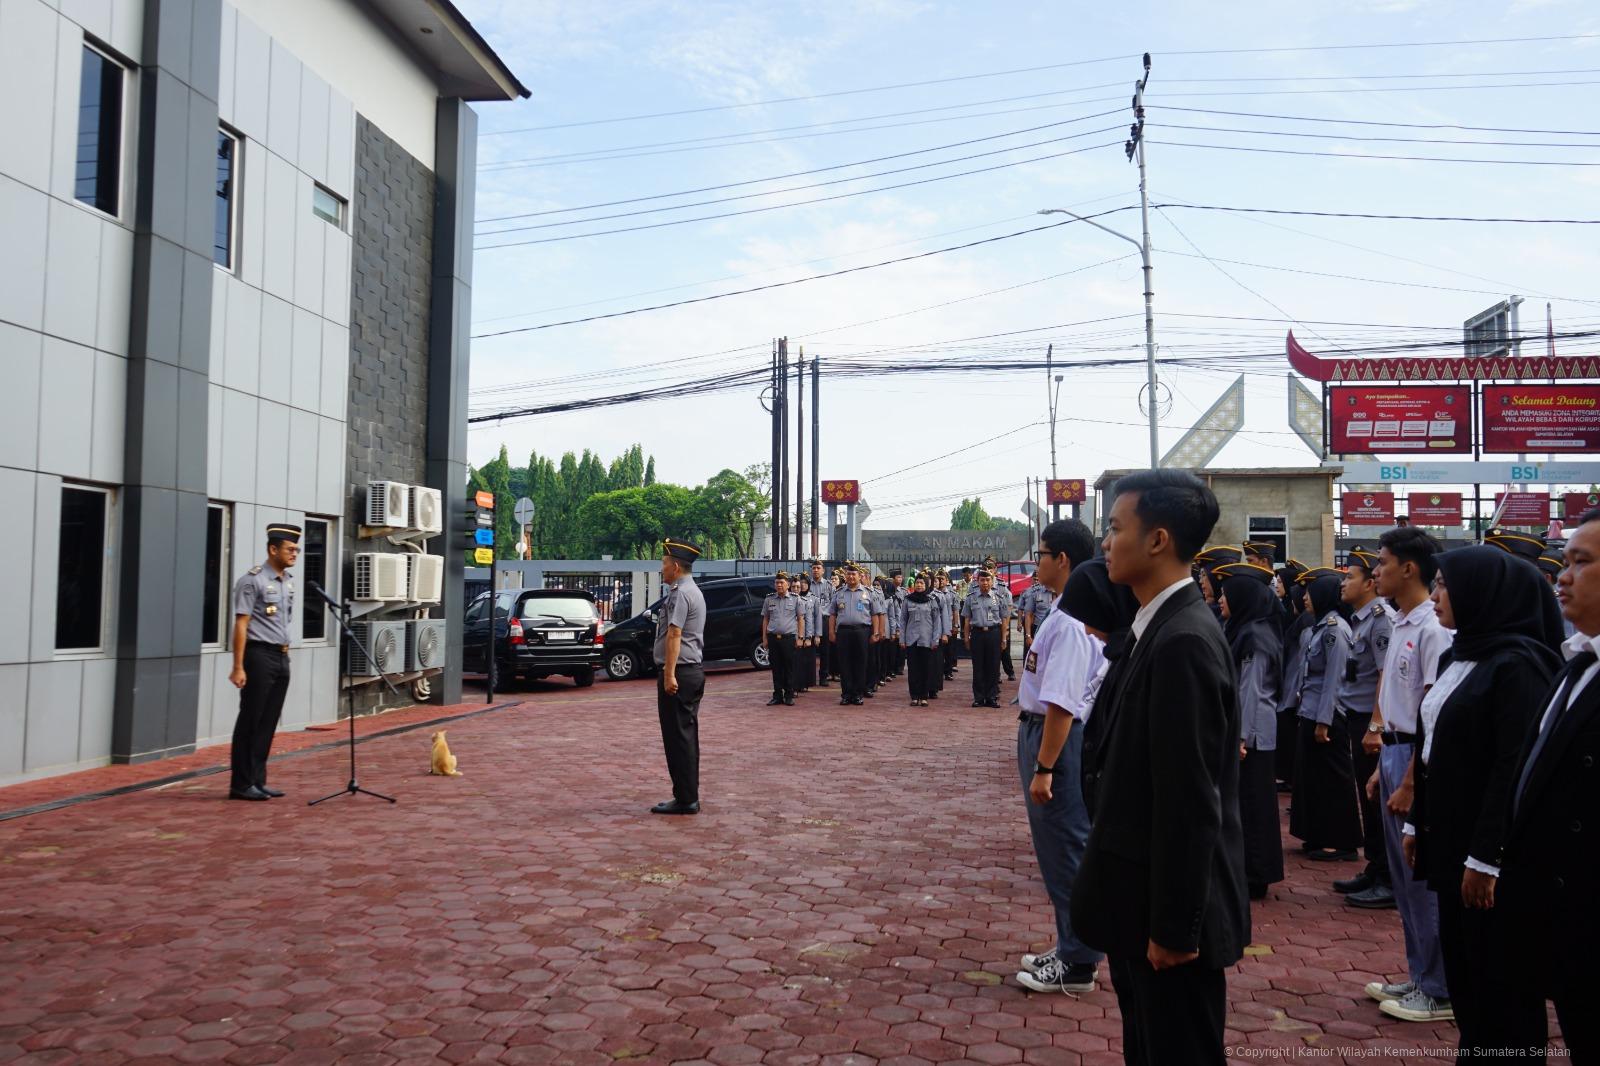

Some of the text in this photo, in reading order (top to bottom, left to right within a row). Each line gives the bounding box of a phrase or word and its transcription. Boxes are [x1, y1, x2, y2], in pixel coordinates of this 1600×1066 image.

[1511, 395, 1596, 407] Selamat Datang
[1381, 466, 1407, 480] BSI
[1511, 466, 1538, 480] BSI
[948, 536, 1006, 549] MAKAM
